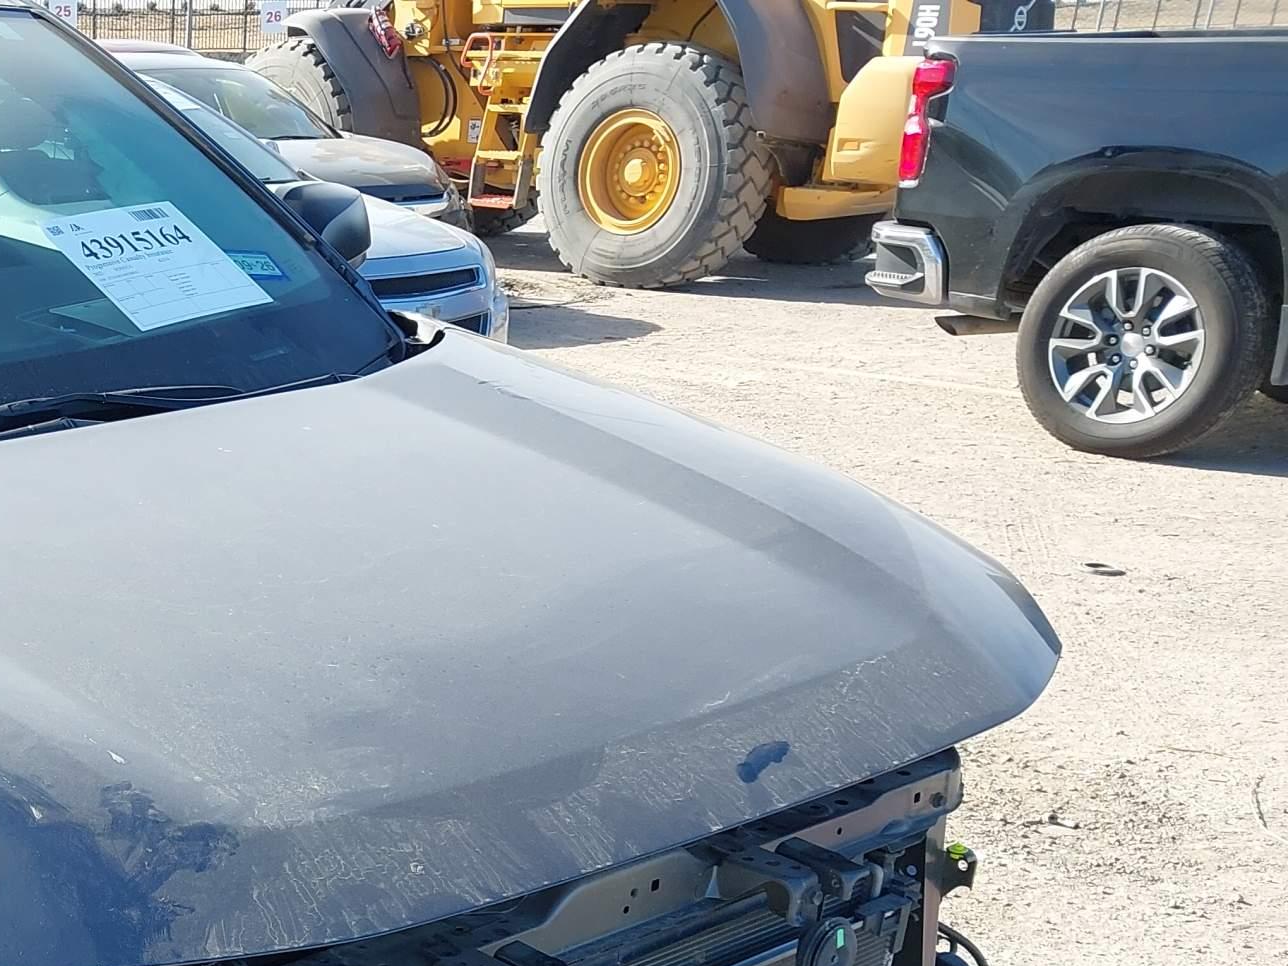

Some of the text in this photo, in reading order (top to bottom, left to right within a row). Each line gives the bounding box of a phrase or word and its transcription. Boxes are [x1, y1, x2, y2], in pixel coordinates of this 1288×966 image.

[55, 5, 72, 17] 25
[266, 10, 282, 23] 26
[80, 223, 193, 261] 43915164
